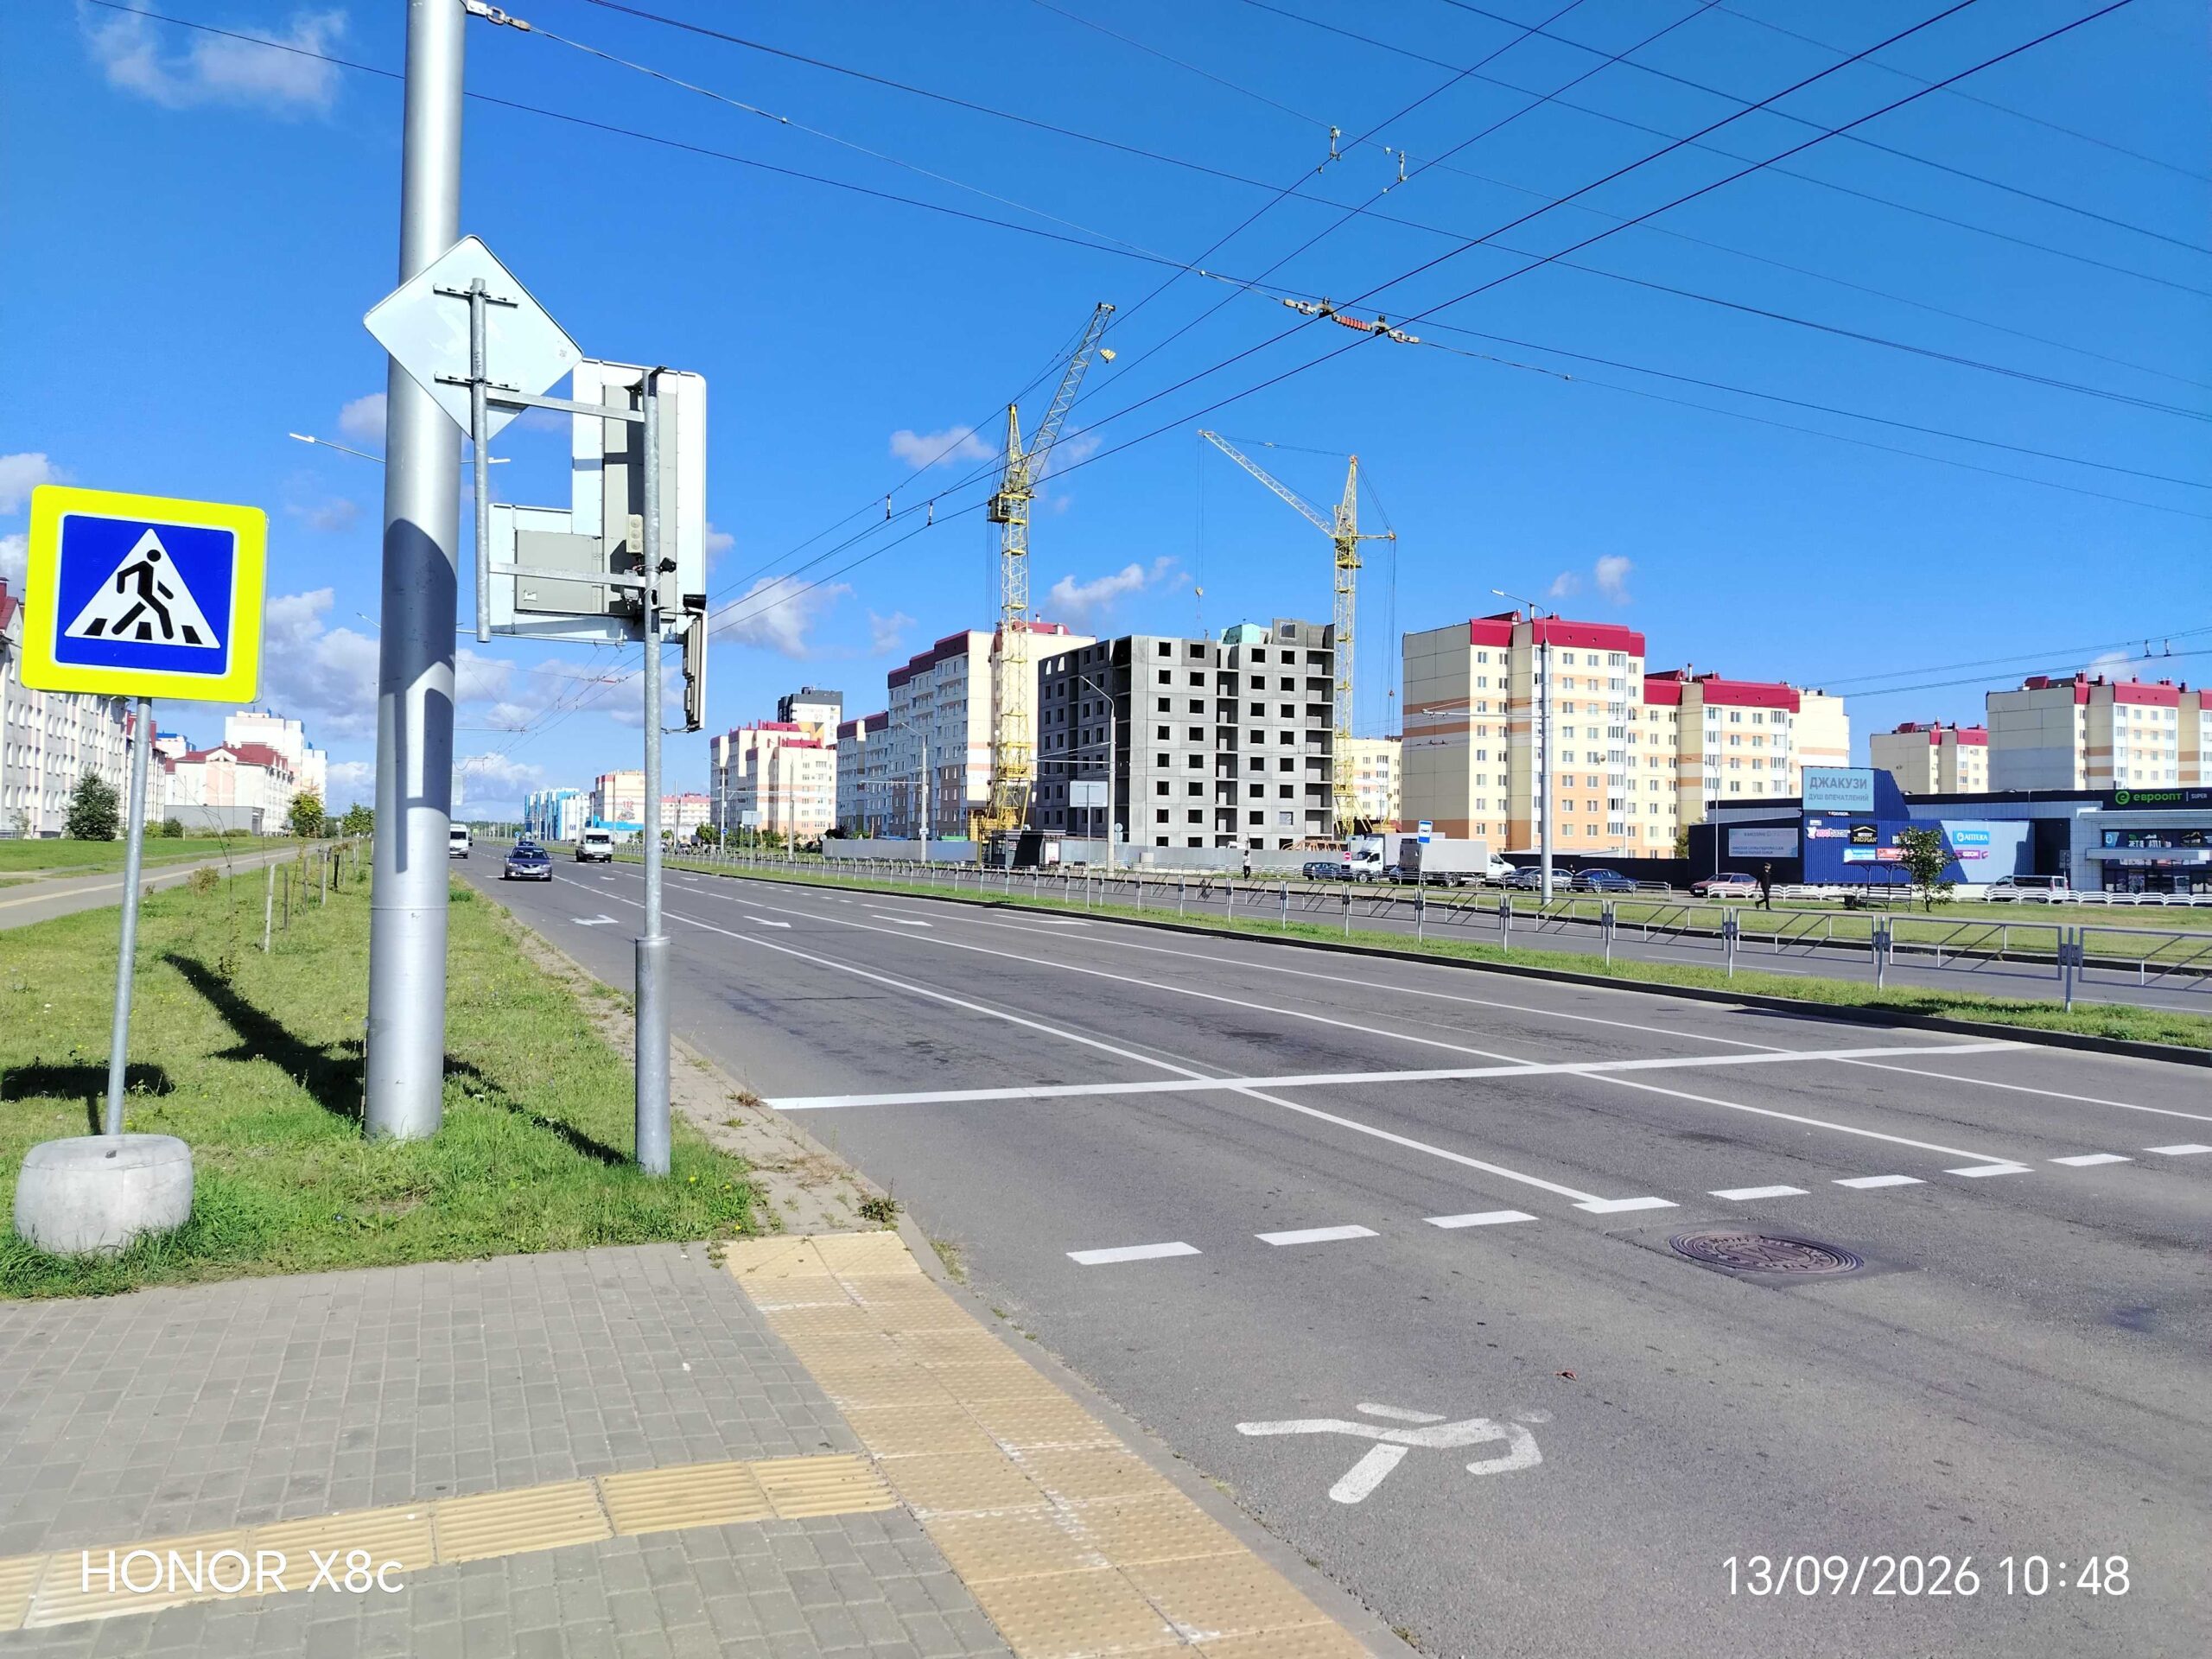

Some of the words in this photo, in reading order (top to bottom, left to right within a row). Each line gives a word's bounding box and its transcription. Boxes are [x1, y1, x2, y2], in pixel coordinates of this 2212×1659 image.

[1809, 776, 1867, 790] ДЖАКУЗИ
[1825, 793, 1869, 802] ВПЕЧАТЛЕНИЙ
[2133, 793, 2183, 803] евроопт
